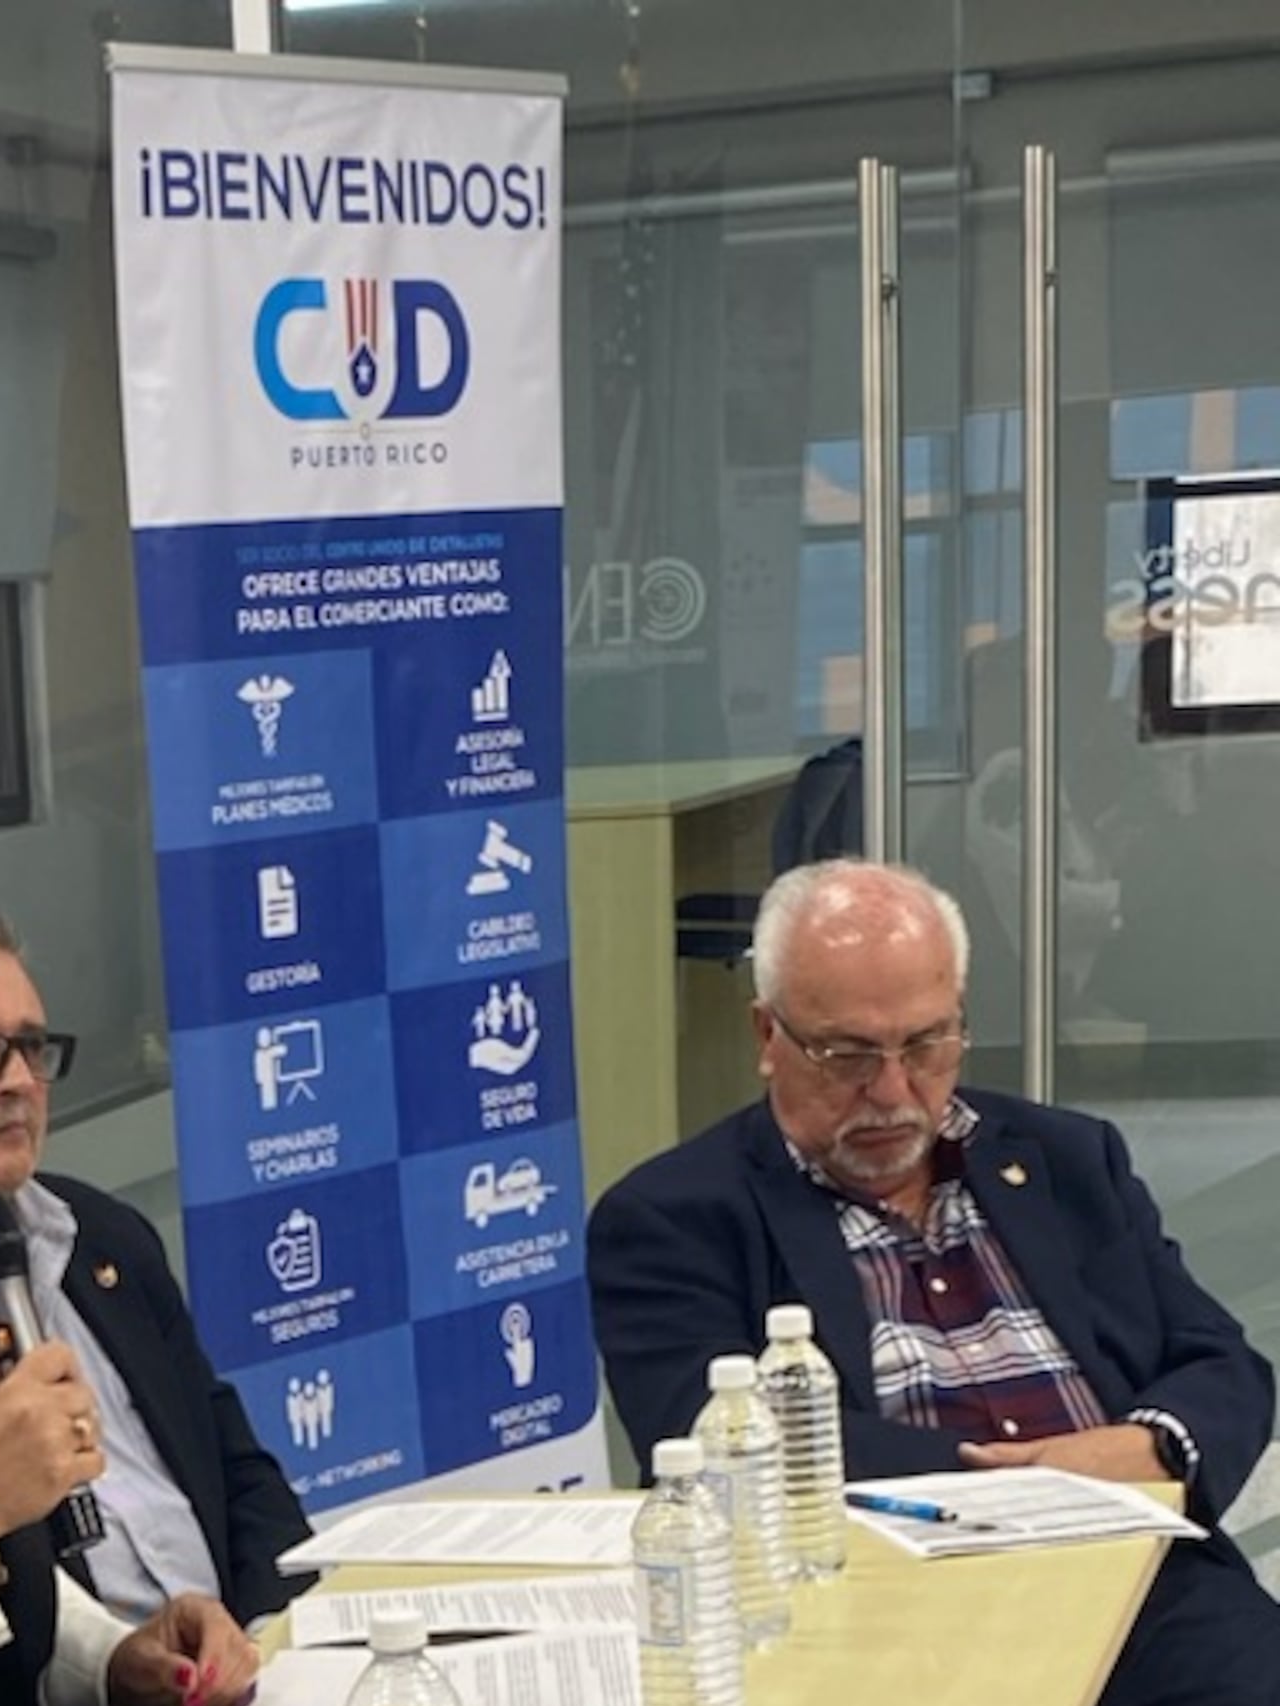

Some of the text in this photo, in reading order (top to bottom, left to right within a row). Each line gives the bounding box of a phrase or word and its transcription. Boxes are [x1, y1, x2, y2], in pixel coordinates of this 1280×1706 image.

[140, 148, 547, 230] ¡BIENVENIDOS!
[291, 443, 447, 467] PUERTO RICO
[242, 558, 501, 599] OFRECE GRANDES VENTAJAS
[237, 607, 291, 634] PARA
[294, 604, 317, 630] EL
[321, 594, 446, 628] COMERCIANTE
[445, 778, 458, 798] Y
[212, 797, 267, 825] PLANES
[247, 1122, 339, 1161] SEMINARIOS
